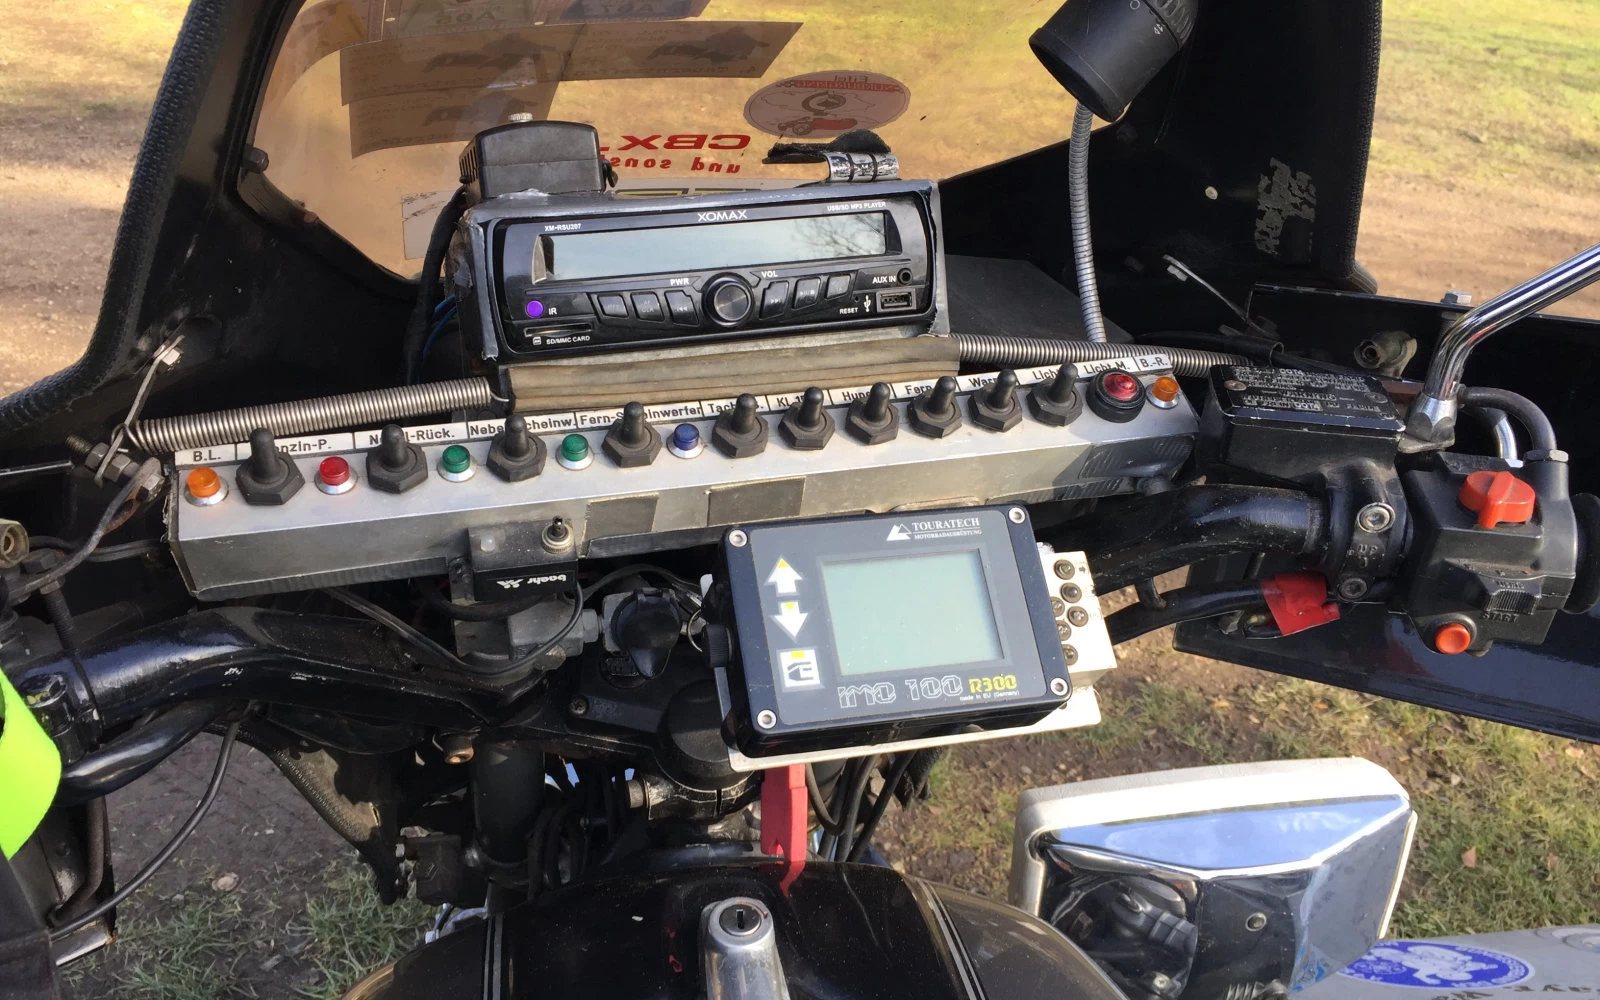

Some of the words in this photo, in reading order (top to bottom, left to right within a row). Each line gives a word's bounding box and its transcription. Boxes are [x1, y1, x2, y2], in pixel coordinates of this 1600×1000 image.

[864, 201, 887, 209] PLAYER
[698, 209, 748, 222] XOMAX
[760, 270, 779, 278] VOL
[669, 277, 690, 286] PWR
[872, 276, 888, 284] AUX
[888, 275, 897, 283] IN
[547, 306, 557, 316] IR
[839, 307, 859, 315] RESET
[572, 335, 591, 343] CARD
[193, 449, 222, 462] B.L.
[912, 517, 980, 532] TOURATECH
[527, 574, 566, 585] baehr
[904, 674, 963, 701] 100
[968, 674, 1018, 694] R300
[982, 691, 992, 699] EU
